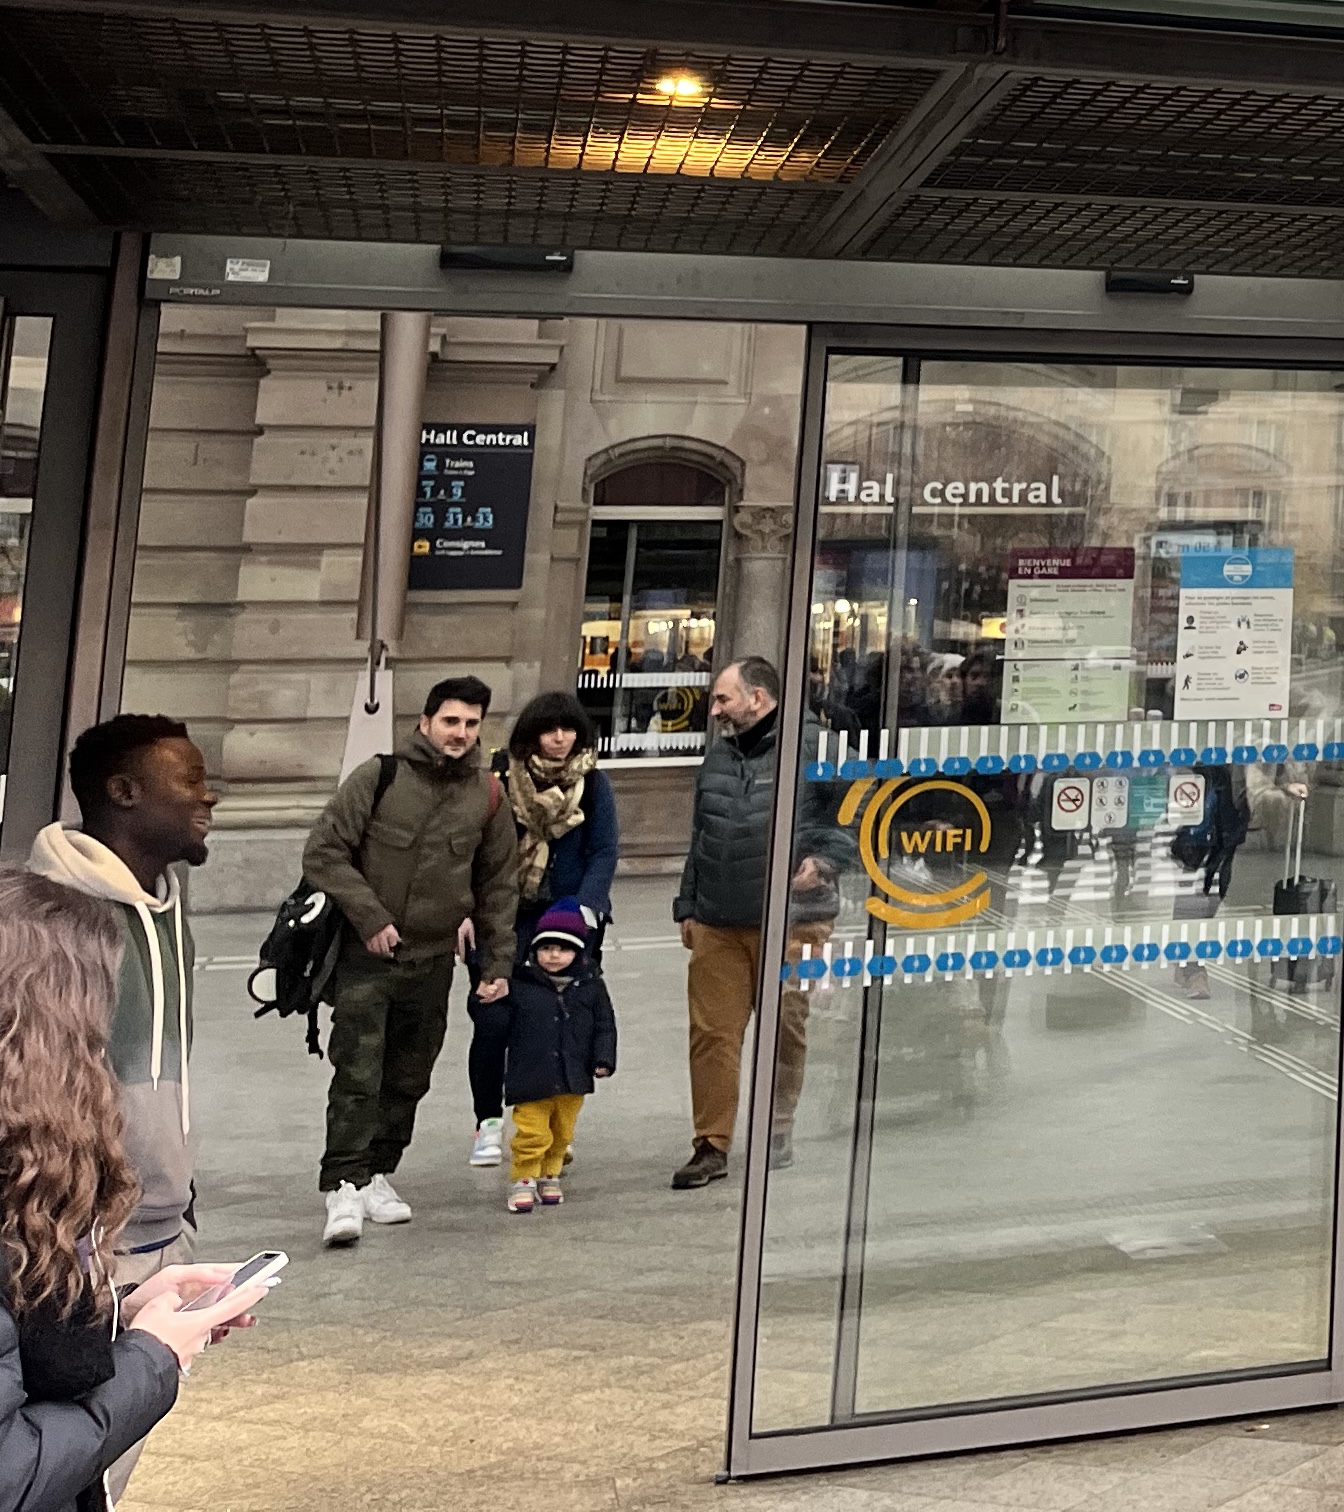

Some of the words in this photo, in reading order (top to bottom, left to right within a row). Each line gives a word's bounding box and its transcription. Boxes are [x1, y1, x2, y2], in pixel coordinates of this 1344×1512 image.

[421, 428, 458, 445] Hall
[461, 429, 530, 446] Central
[825, 472, 896, 504] Hal
[922, 474, 1063, 505] central
[1018, 558, 1072, 568] BIENVENUE
[1018, 567, 1031, 575] EN
[1034, 567, 1060, 576] GARE
[900, 828, 972, 854] WIFI
